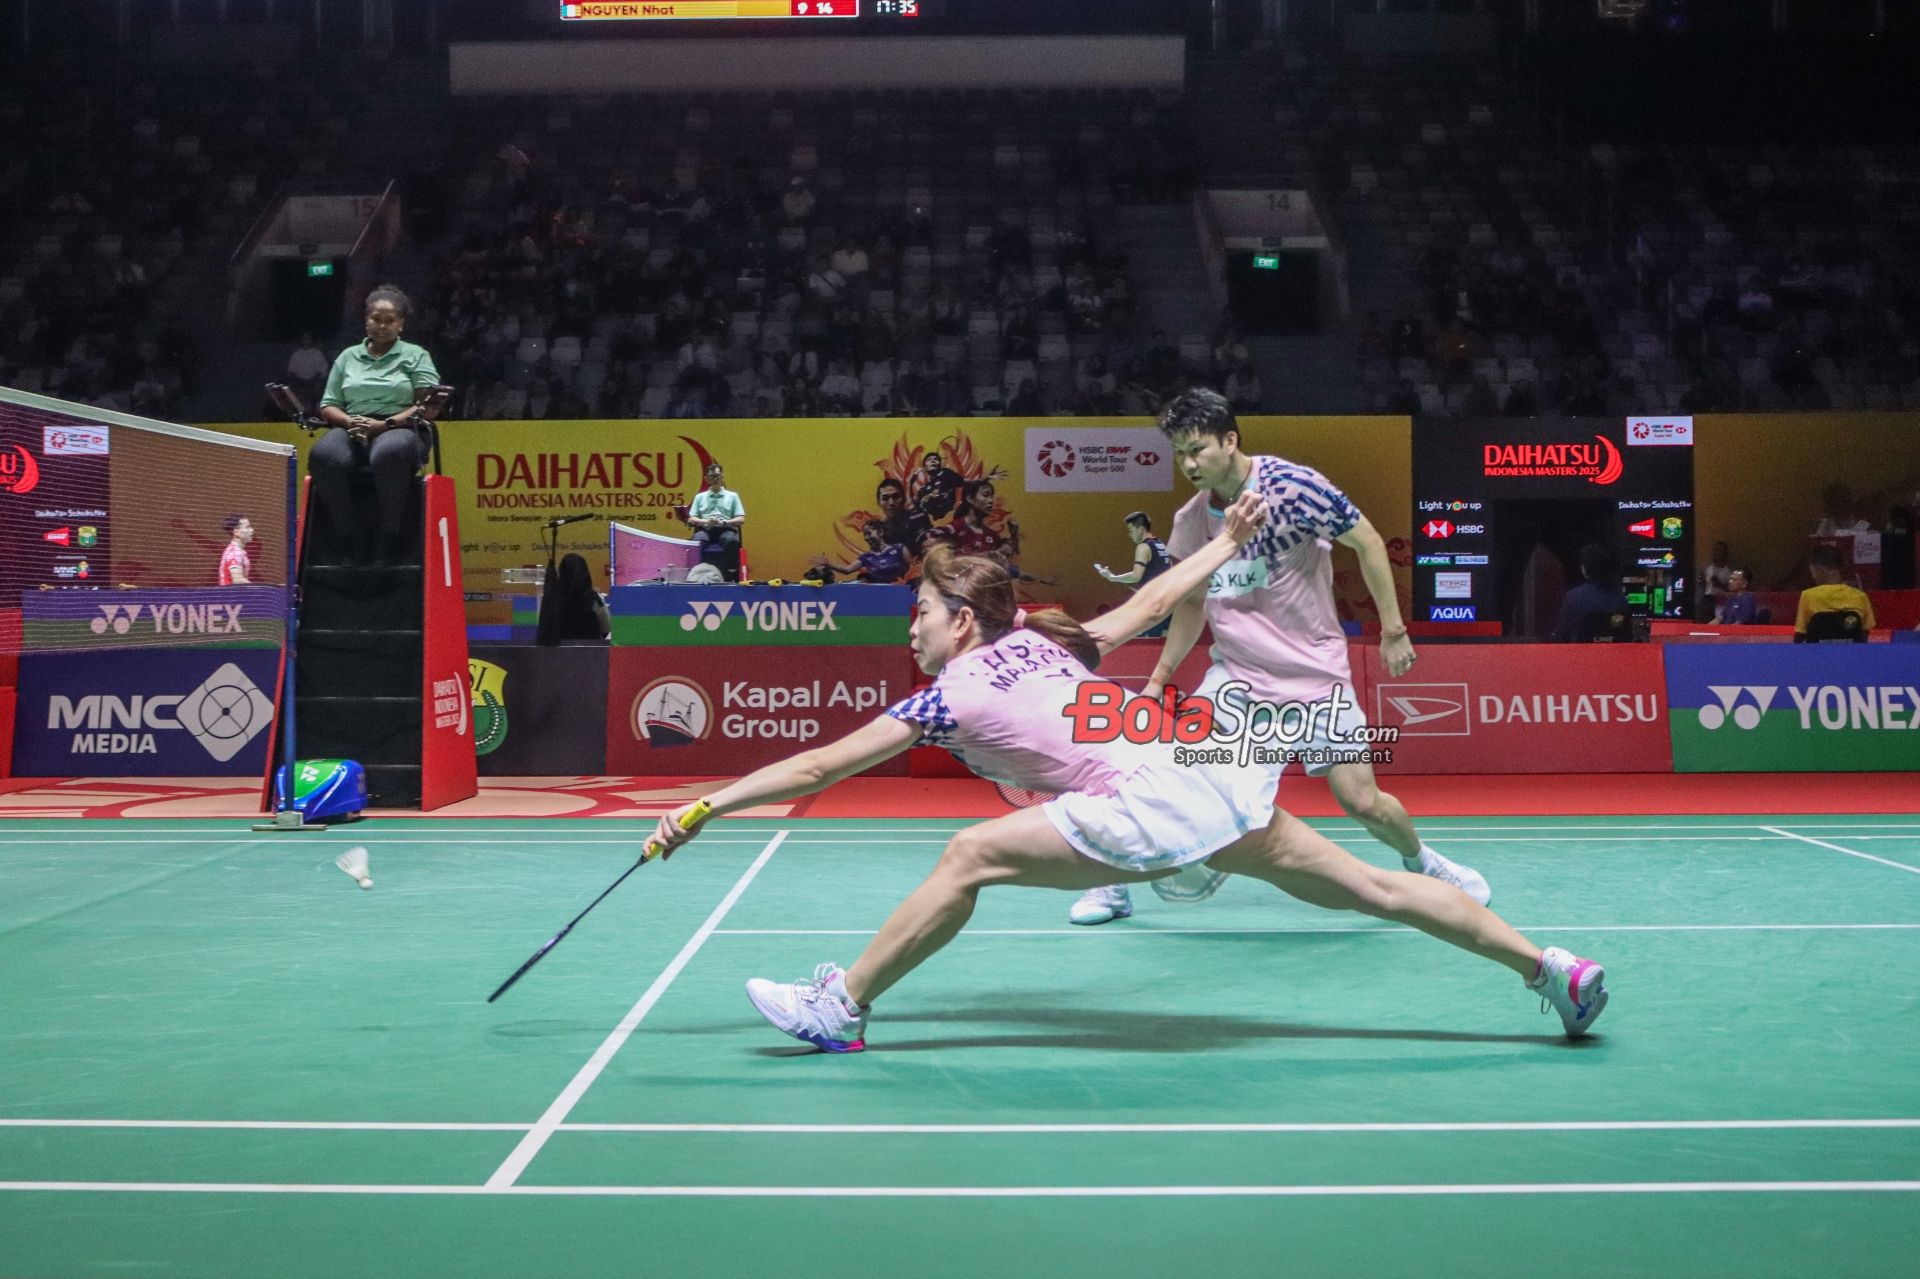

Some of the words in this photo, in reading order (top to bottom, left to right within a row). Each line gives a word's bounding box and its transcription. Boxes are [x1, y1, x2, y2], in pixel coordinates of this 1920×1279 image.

[582, 5, 638, 16] NGUYEN
[642, 5, 675, 16] Nhat
[797, 2, 808, 15] 9
[815, 2, 834, 15] 16
[876, 0, 917, 14] 17:35
[1079, 446, 1104, 454] HSBC
[1106, 446, 1132, 454] BWF
[1082, 455, 1108, 463] World
[1109, 455, 1128, 463] Tour
[1484, 444, 1600, 466] DAIHATSU
[476, 452, 684, 489] DAIHATSU
[1084, 464, 1108, 473] Super
[1109, 464, 1125, 473] 500
[1484, 467, 1534, 476] INDONESIA
[1534, 467, 1578, 476] MASTERS
[1579, 466, 1600, 476] 2025
[477, 494, 565, 508] INDONESIA
[568, 494, 644, 508] MASTERS
[646, 492, 685, 507] 2025
[1419, 501, 1443, 511] Light
[1470, 503, 1482, 511] up
[1456, 525, 1485, 534] HSBC
[438, 517, 452, 587] 1
[1228, 572, 1257, 587] KLK
[149, 604, 243, 633] YONEX
[741, 600, 838, 632] YONEX
[1431, 607, 1475, 620] AQUA
[722, 680, 820, 711] Kapal
[827, 680, 887, 711] Api
[47, 695, 188, 730] MNC
[1479, 694, 1658, 724] DAIHATSU
[1787, 685, 1920, 730] YONEX
[721, 714, 820, 741] Group
[71, 733, 157, 754] MEDIA
